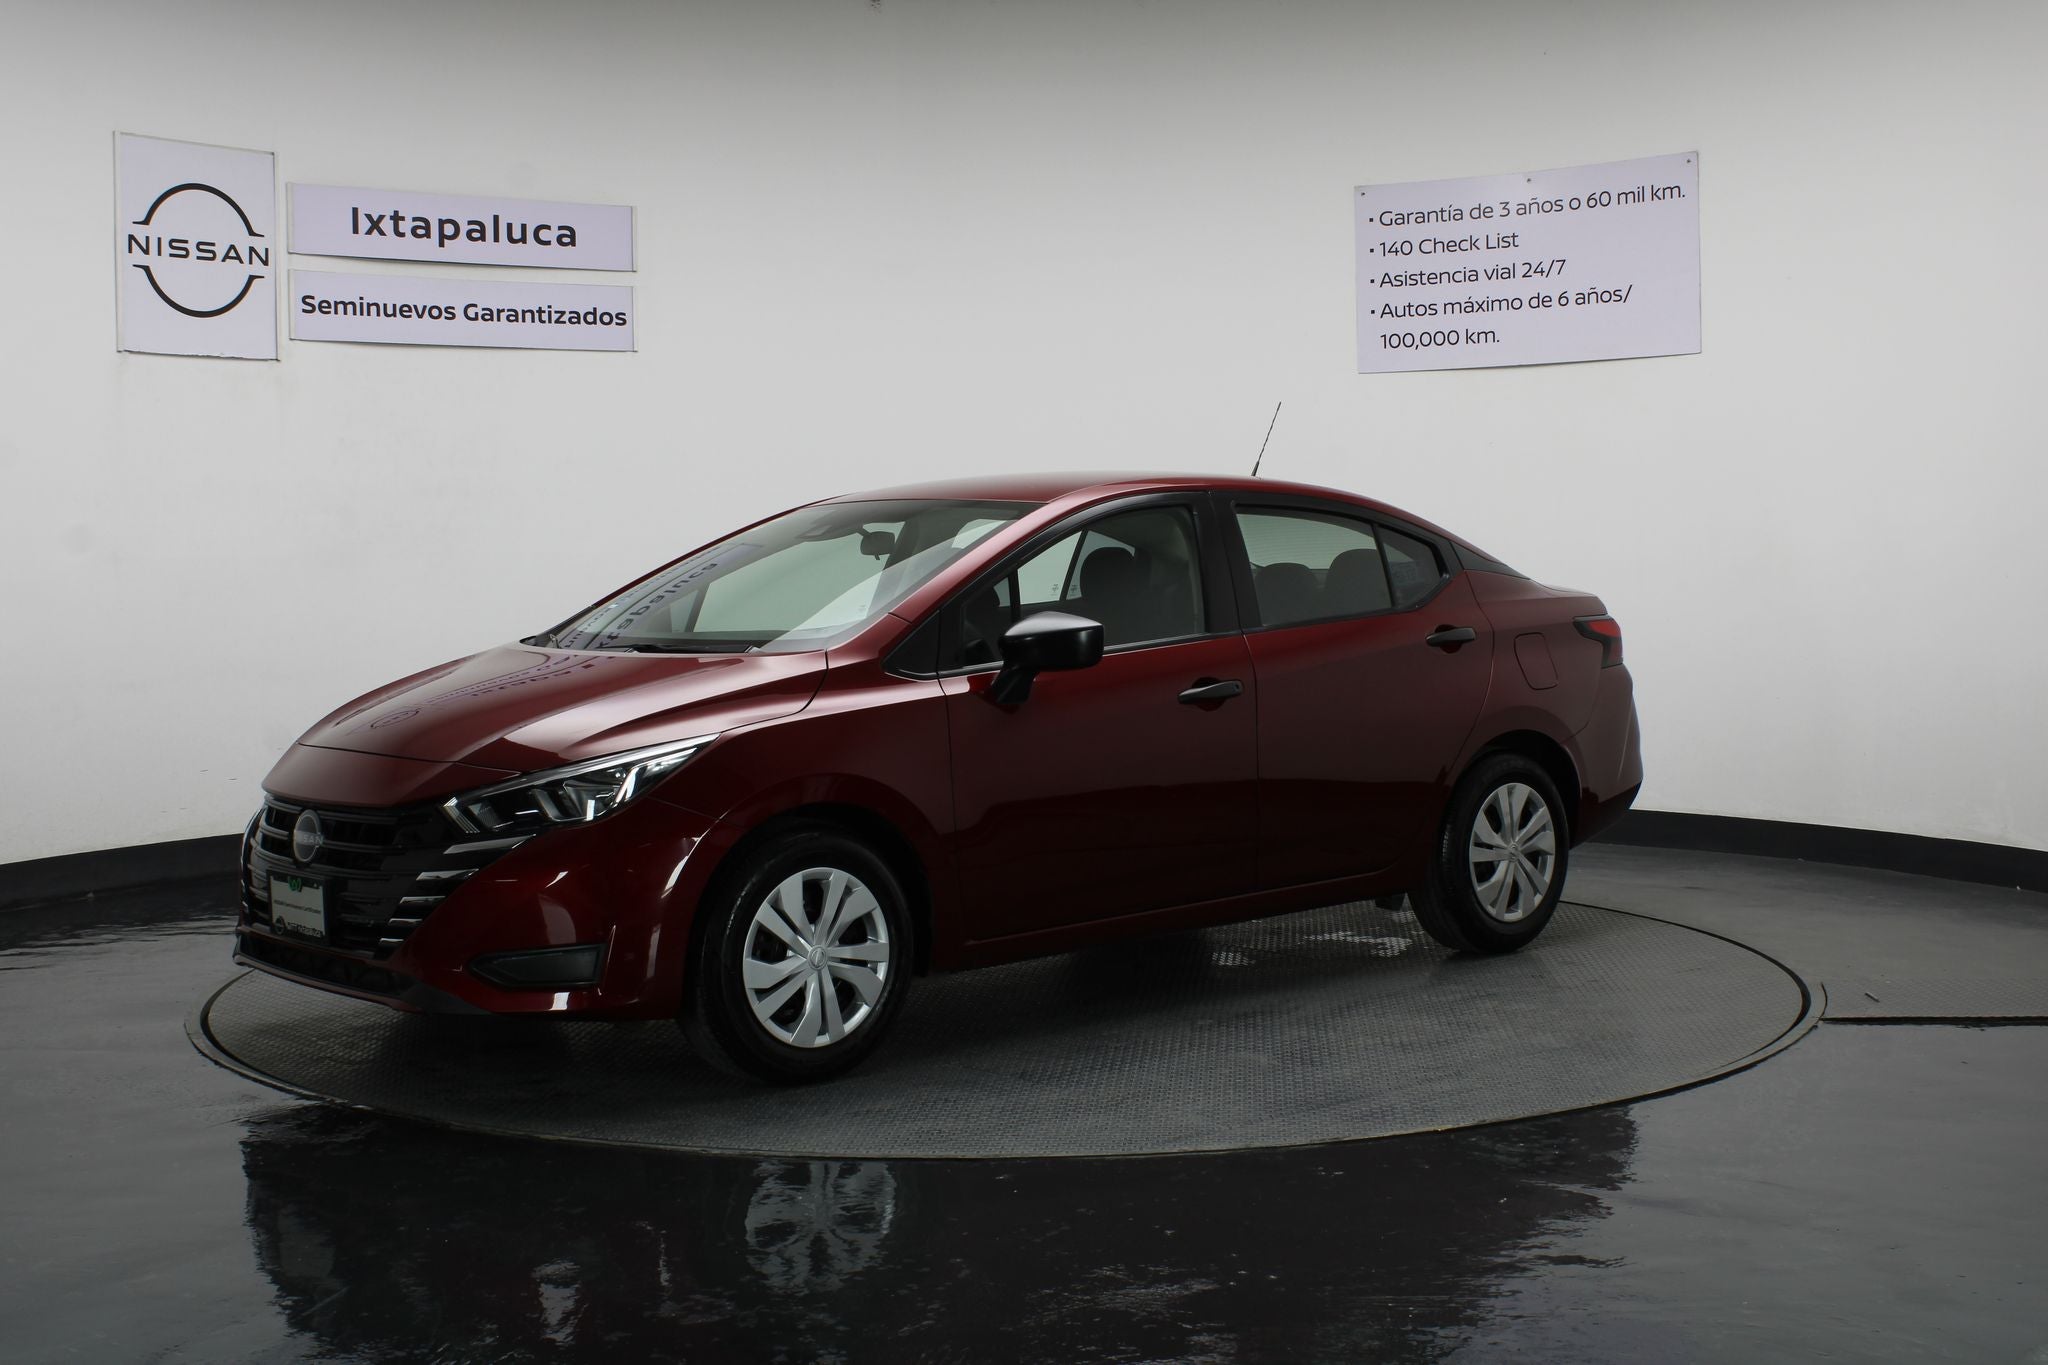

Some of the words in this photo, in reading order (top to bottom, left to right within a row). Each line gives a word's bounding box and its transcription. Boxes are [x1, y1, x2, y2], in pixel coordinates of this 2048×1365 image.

[1380, 205, 1463, 226] Garantía
[1470, 203, 1493, 219] de
[1500, 202, 1510, 217] 3
[1516, 198, 1563, 215] años
[1569, 198, 1581, 210] o
[1587, 191, 1611, 208] 60
[1618, 186, 1644, 205] mil
[1651, 185, 1685, 201] km.
[352, 207, 576, 248] Ixtapaluca
[128, 234, 269, 266] NISSAN
[1380, 240, 1413, 256] 140
[1419, 235, 1480, 254] Check
[1486, 233, 1519, 249] List
[1380, 267, 1478, 288] Asistencia
[1484, 263, 1515, 280] vial
[1522, 259, 1566, 278] 24/7
[302, 295, 456, 320] Seminuevos
[463, 303, 627, 326] Garantizados
[1380, 302, 1437, 318] Autos
[1444, 296, 1523, 314] máximo
[1528, 292, 1552, 309] de
[1558, 291, 1569, 306] 6
[1575, 285, 1632, 305] años/
[1380, 330, 1459, 350] 100,000
[1466, 329, 1499, 344] km.
